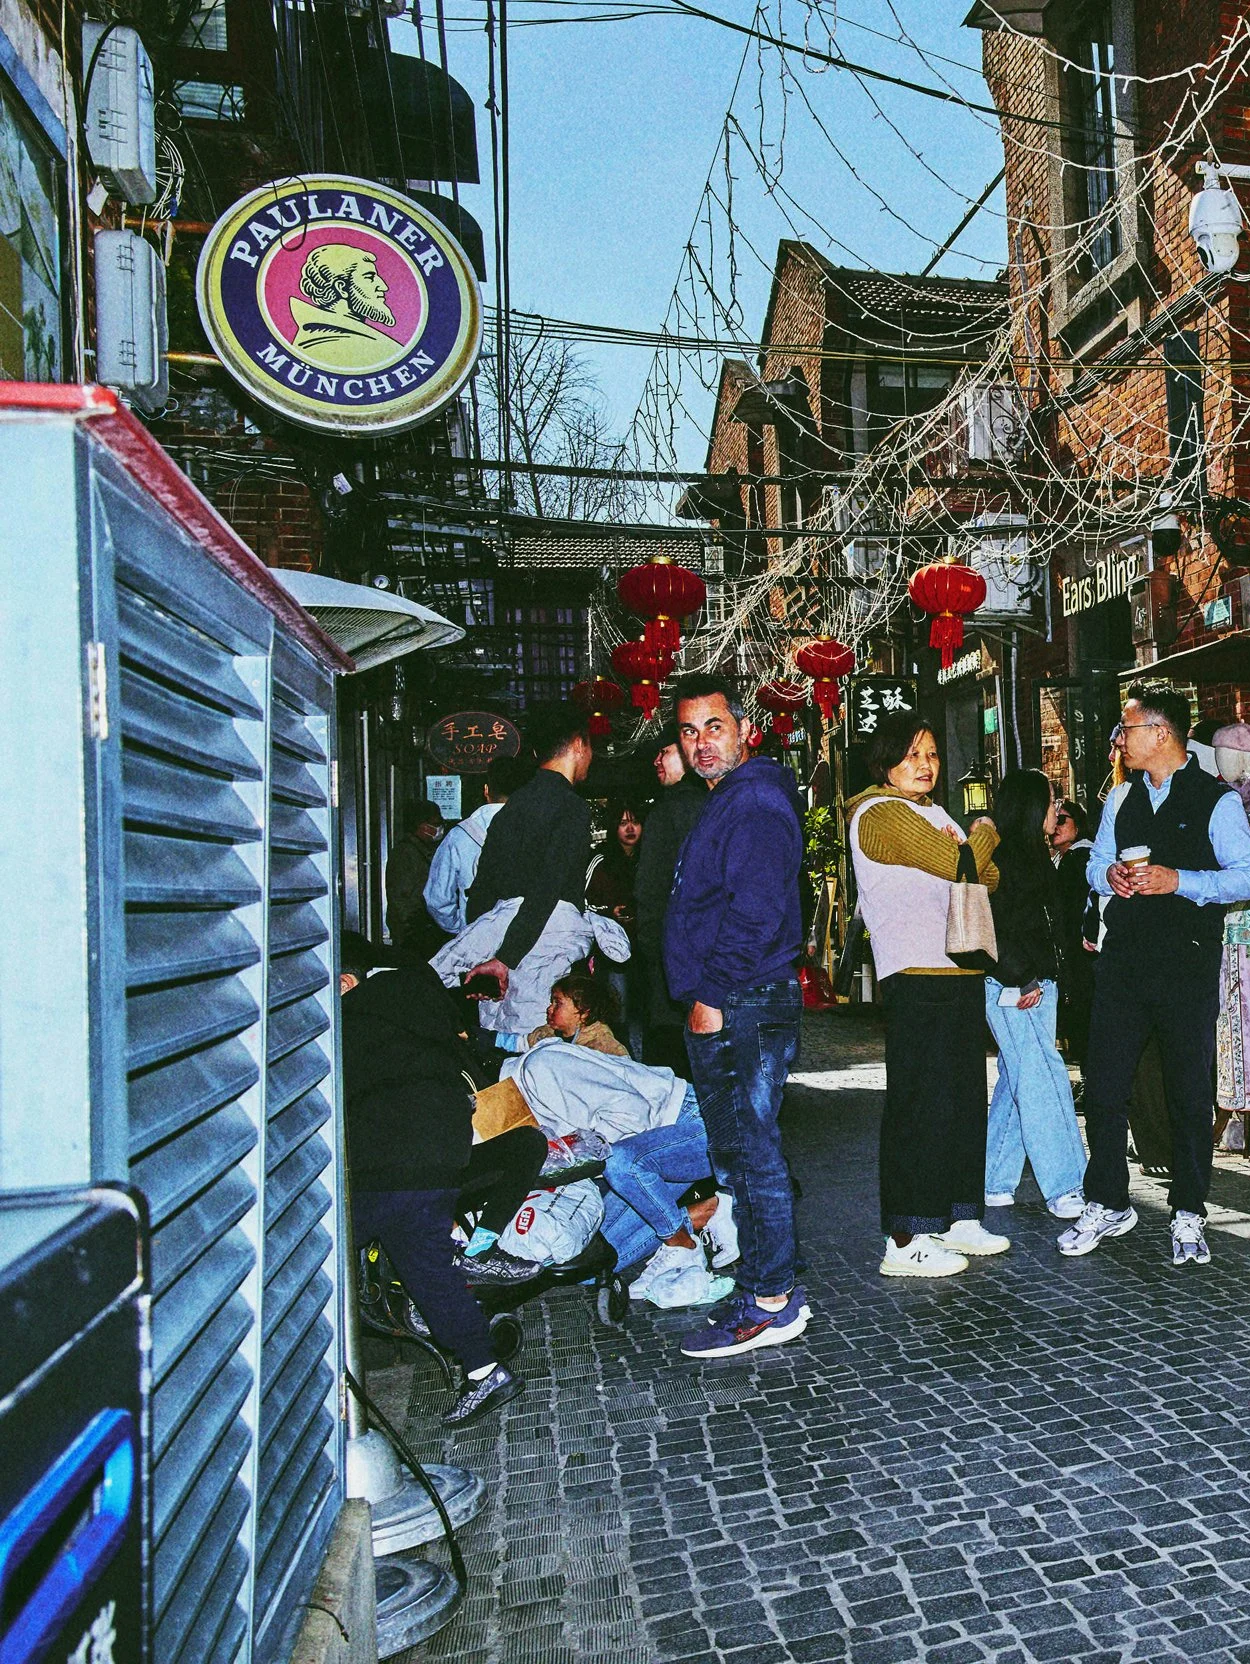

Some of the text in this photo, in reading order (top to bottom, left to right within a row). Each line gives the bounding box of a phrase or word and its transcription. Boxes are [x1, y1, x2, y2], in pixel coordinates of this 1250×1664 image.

[230, 194, 444, 278] PAULANER
[256, 342, 436, 399] MÜNCHEN
[1096, 554, 1141, 604] Bling
[441, 721, 508, 741] 手工皂
[455, 743, 497, 754] SOAP
[518, 1209, 532, 1231] IGA
